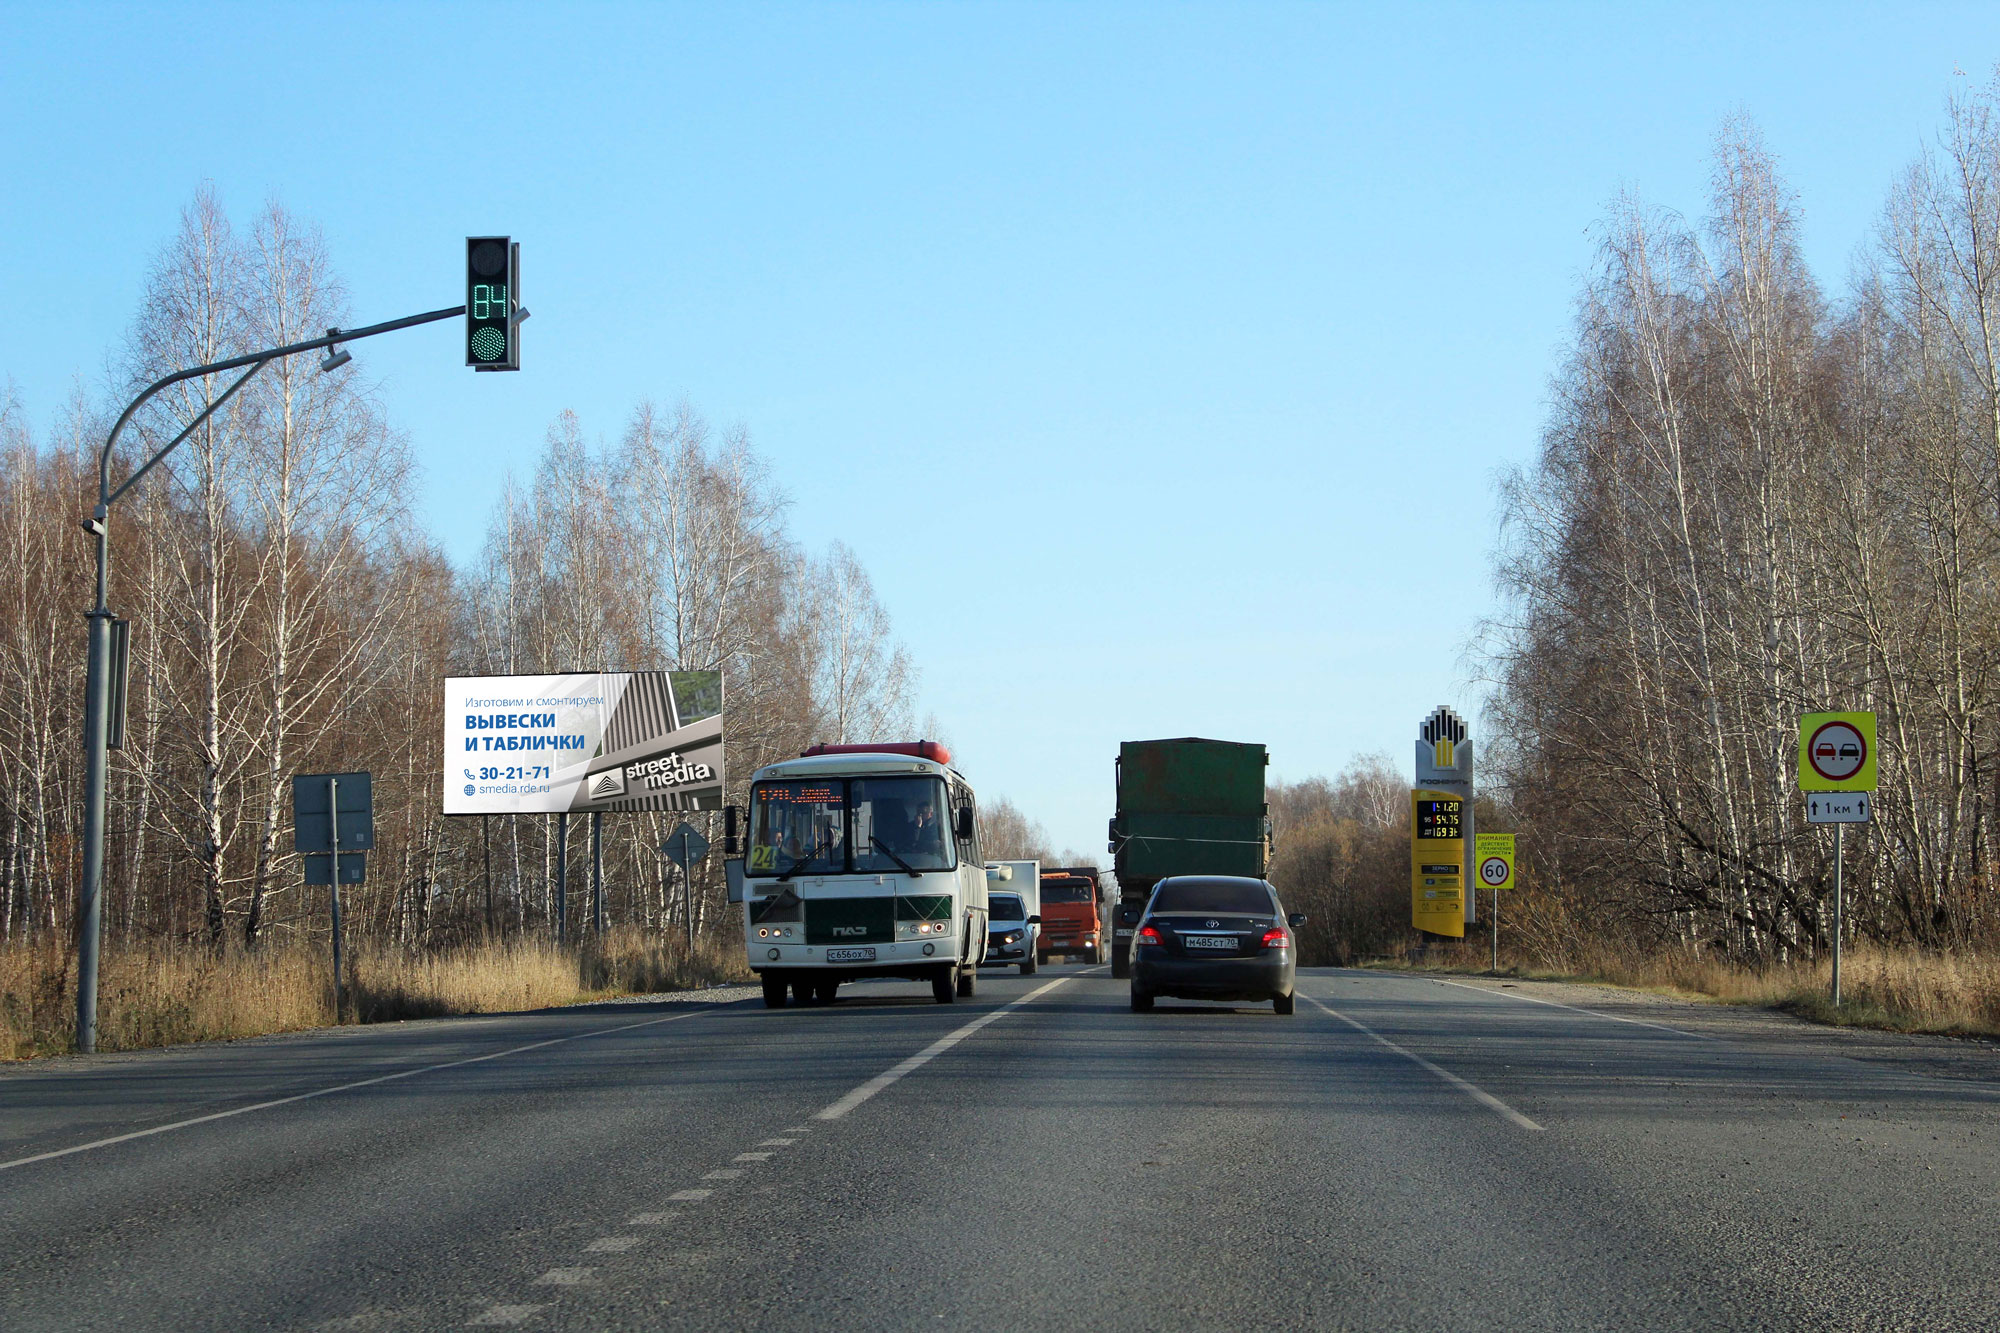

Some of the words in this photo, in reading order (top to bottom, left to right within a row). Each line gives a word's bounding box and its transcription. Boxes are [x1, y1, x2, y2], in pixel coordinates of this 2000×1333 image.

[474, 284, 506, 319] 84
[465, 697, 524, 708] Изготовим
[526, 698, 534, 706] и
[536, 696, 604, 708] смонтируем
[465, 713, 556, 730] ВЫВЕСКИ
[465, 737, 478, 751] И
[482, 735, 585, 751] ТАБЛИЧКИ
[479, 766, 550, 780] 30-21-71
[626, 752, 682, 779] street
[644, 761, 711, 790] media
[479, 783, 550, 795] smedia.rde.ru
[754, 847, 775, 867] 24
[1485, 864, 1504, 878] 60
[832, 926, 867, 937] ПАЗ
[1189, 937, 1224, 947] М485СТ
